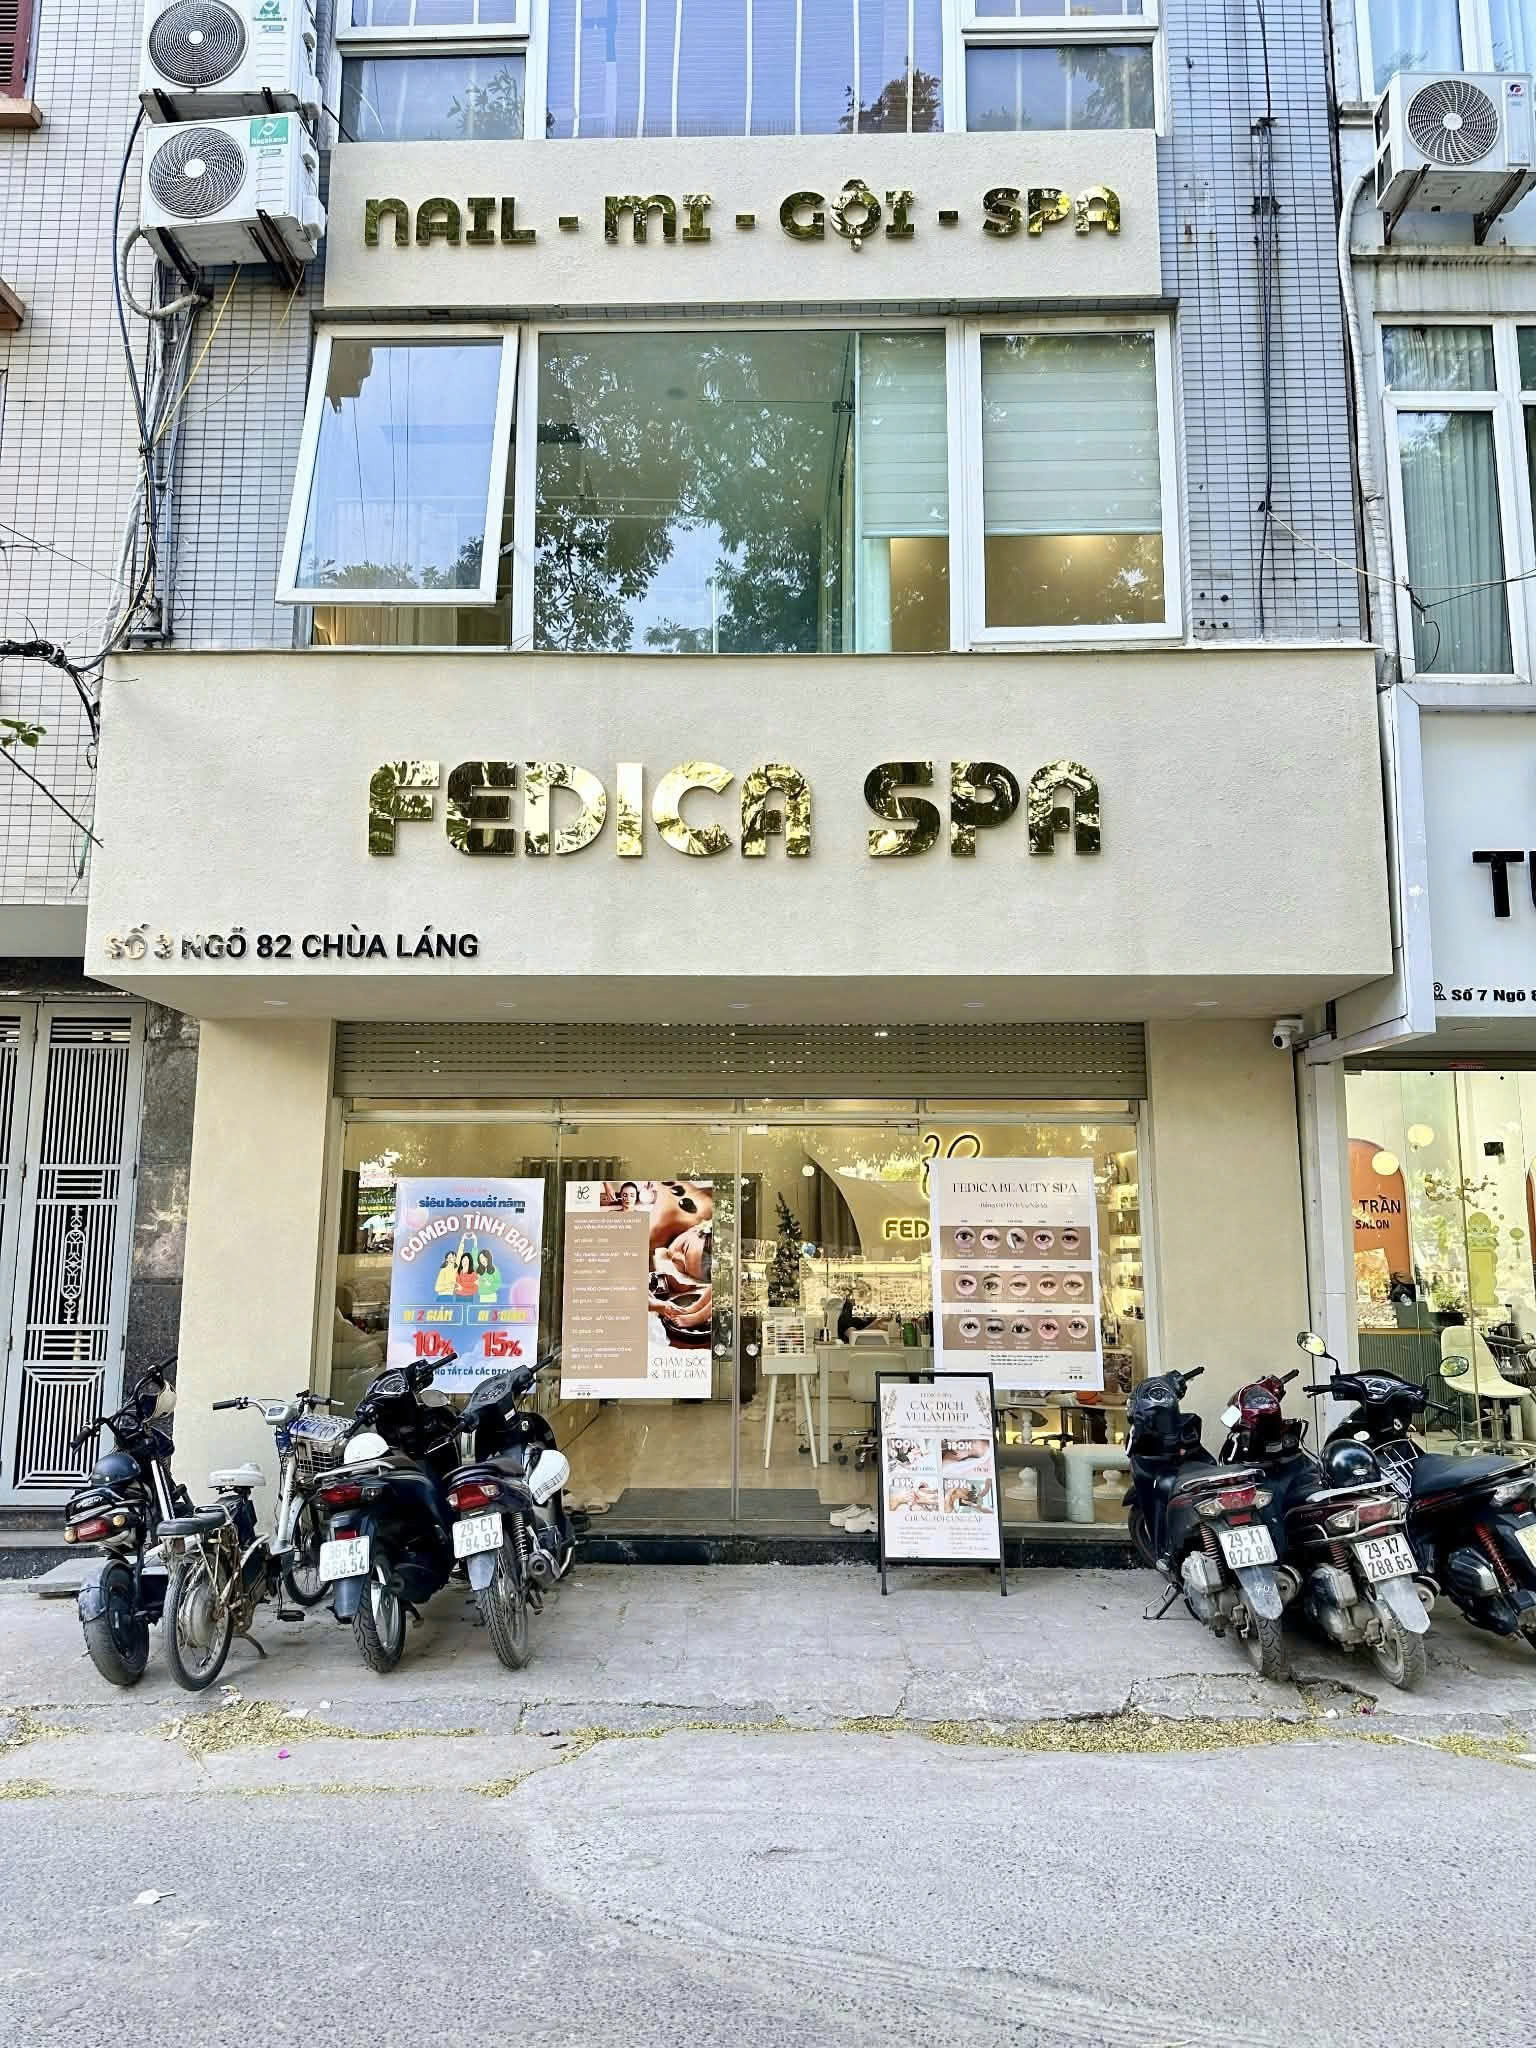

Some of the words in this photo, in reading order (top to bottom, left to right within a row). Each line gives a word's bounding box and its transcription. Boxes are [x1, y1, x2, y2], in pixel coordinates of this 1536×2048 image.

[779, 179, 915, 250] GỘI
[983, 186, 1121, 238] SPA
[369, 761, 811, 857] FEDICA
[864, 760, 1102, 857] SPA
[106, 923, 150, 960] SỐ
[153, 934, 174, 959] 3
[182, 926, 247, 959] NGÕ
[257, 935, 292, 958] 82
[302, 923, 387, 958] CHÙA
[396, 924, 479, 958] LÁNG
[1451, 987, 1474, 1001] Số
[1477, 990, 1488, 1001] 7
[1493, 990, 1526, 1002] Ngõ
[952, 1182, 998, 1193] FEDICA
[1000, 1182, 1050, 1193] BEAUTY
[1052, 1182, 1077, 1193] SPA
[419, 1197, 445, 1208] siêu
[446, 1197, 469, 1208] bão
[400, 1216, 459, 1261] COMBO
[464, 1211, 506, 1236] TÌNH
[1355, 1219, 1389, 1229] SALON
[416, 1310, 425, 1321] 2
[413, 1330, 455, 1356] 10%
[482, 1330, 523, 1357] 15%
[1229, 1528, 1262, 1548] 29-X1
[1365, 1537, 1399, 1560] 29-X7
[1368, 1554, 1413, 1579] 288.65
